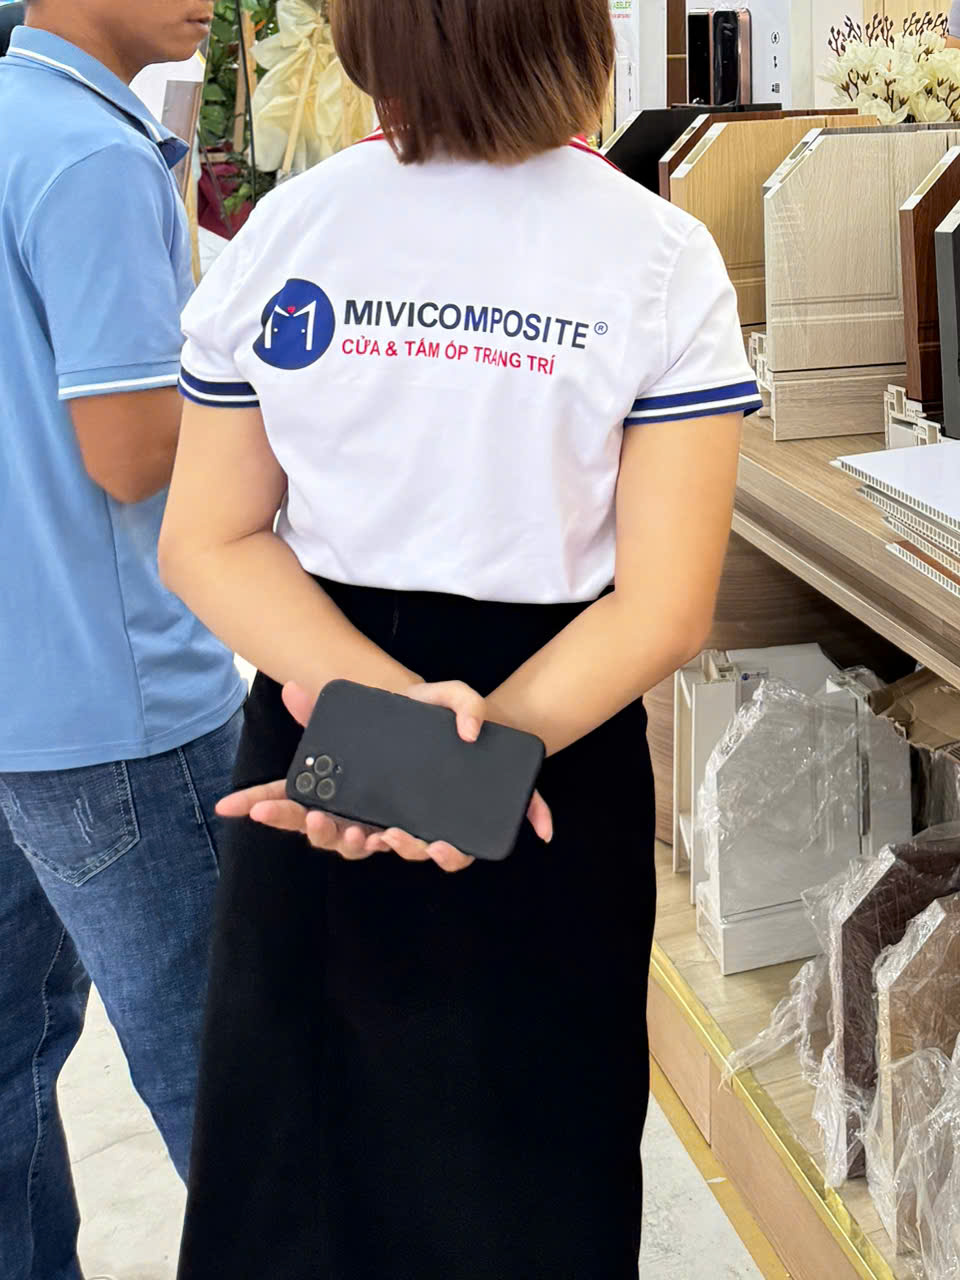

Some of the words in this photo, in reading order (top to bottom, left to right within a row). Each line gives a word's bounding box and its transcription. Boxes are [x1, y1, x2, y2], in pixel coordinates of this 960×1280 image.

[385, 340, 398, 357] &
[473, 345, 522, 369] TRANG
[526, 354, 556, 376] TRÍ
